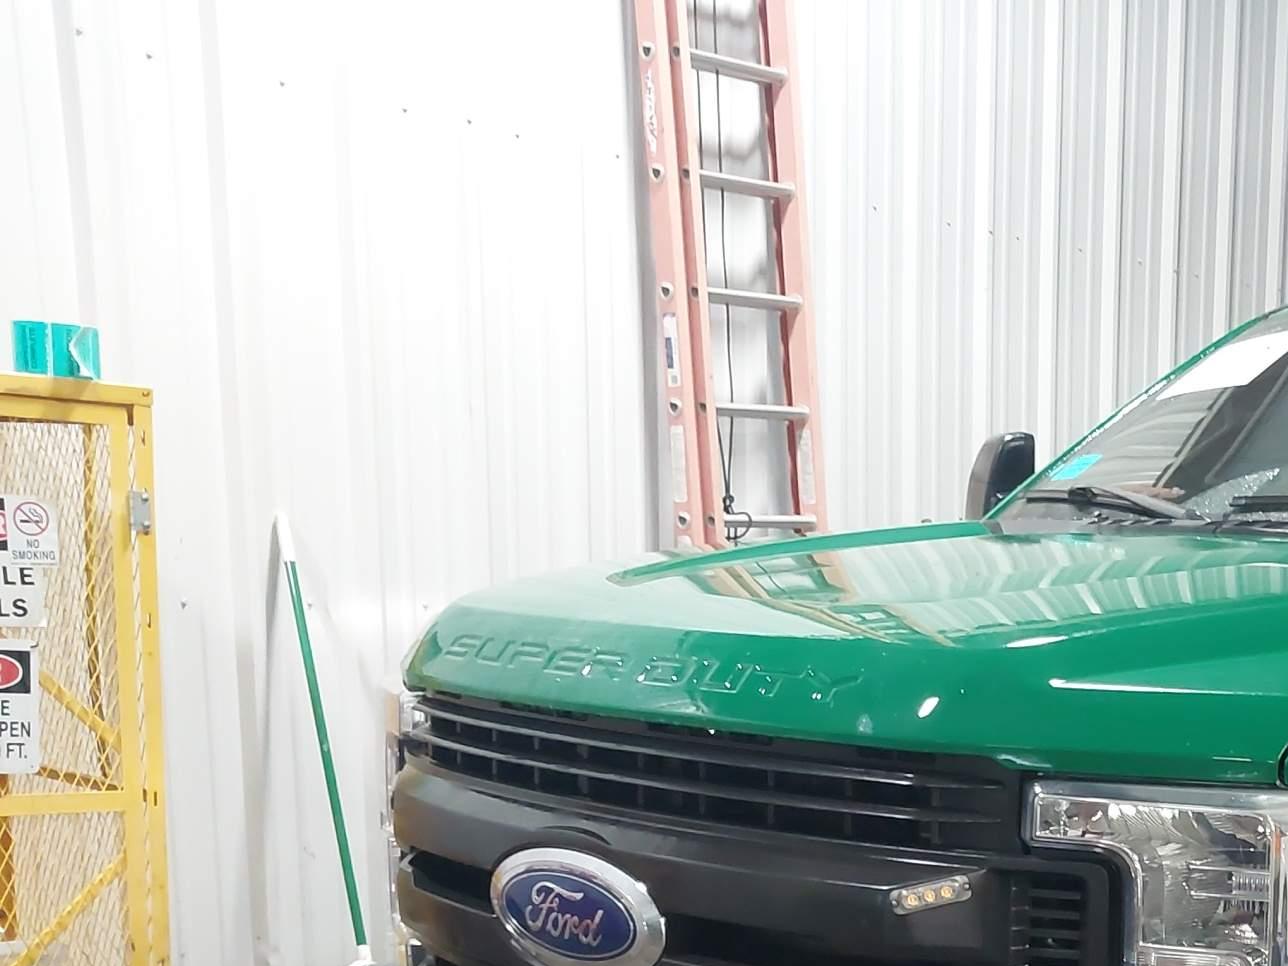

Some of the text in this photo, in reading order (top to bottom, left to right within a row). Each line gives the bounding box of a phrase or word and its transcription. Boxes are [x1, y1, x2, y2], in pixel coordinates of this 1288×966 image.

[11, 550, 56, 561] SMOKING
[26, 539, 40, 549] NO
[443, 633, 865, 707] SUPER DUTY
[524, 881, 604, 947] Ford
